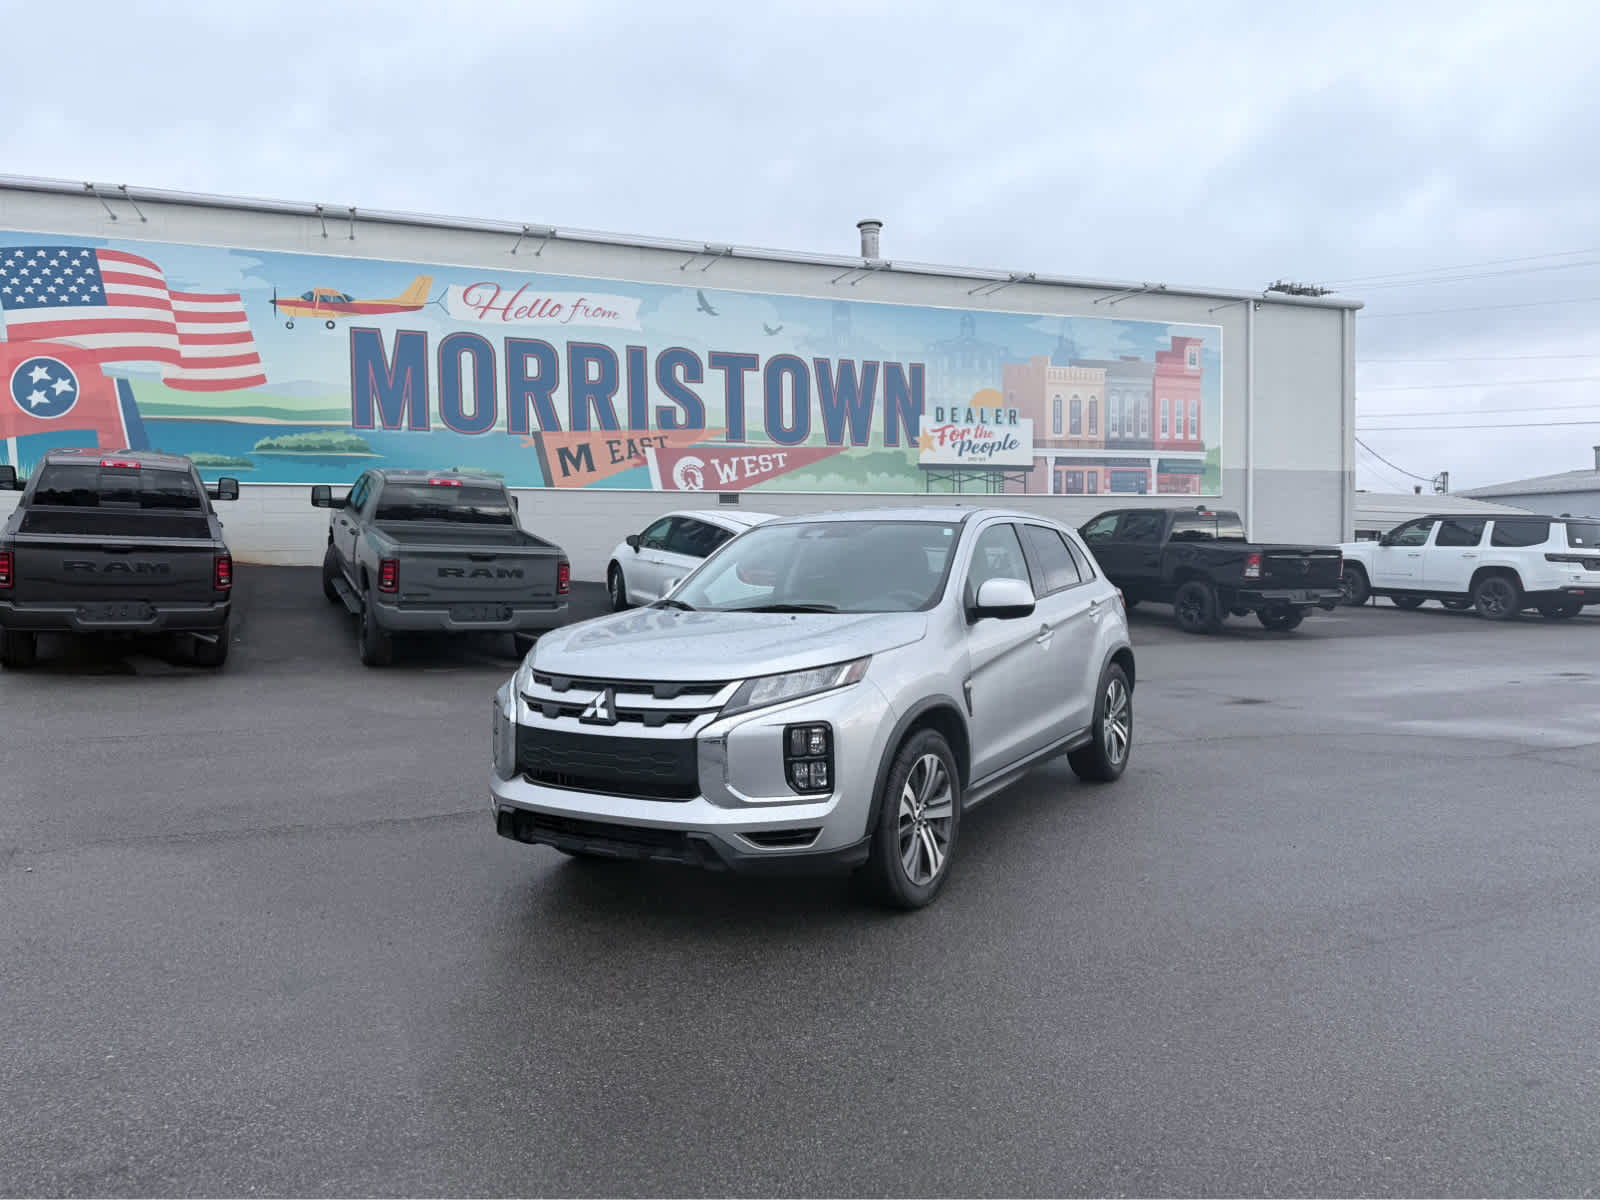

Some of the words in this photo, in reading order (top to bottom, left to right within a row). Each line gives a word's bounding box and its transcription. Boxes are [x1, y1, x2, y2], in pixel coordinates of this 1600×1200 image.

[463, 282, 563, 321] Hello
[560, 297, 620, 324] from
[350, 327, 925, 447] MORRISTOWN
[935, 406, 1017, 425] DEALER
[931, 424, 971, 446] For
[974, 425, 993, 439] the
[952, 433, 1020, 457] People
[556, 442, 597, 477] M
[606, 435, 669, 464] EAST
[710, 452, 788, 484] WEST
[63, 560, 171, 573] RAM
[437, 567, 525, 579] RAM
